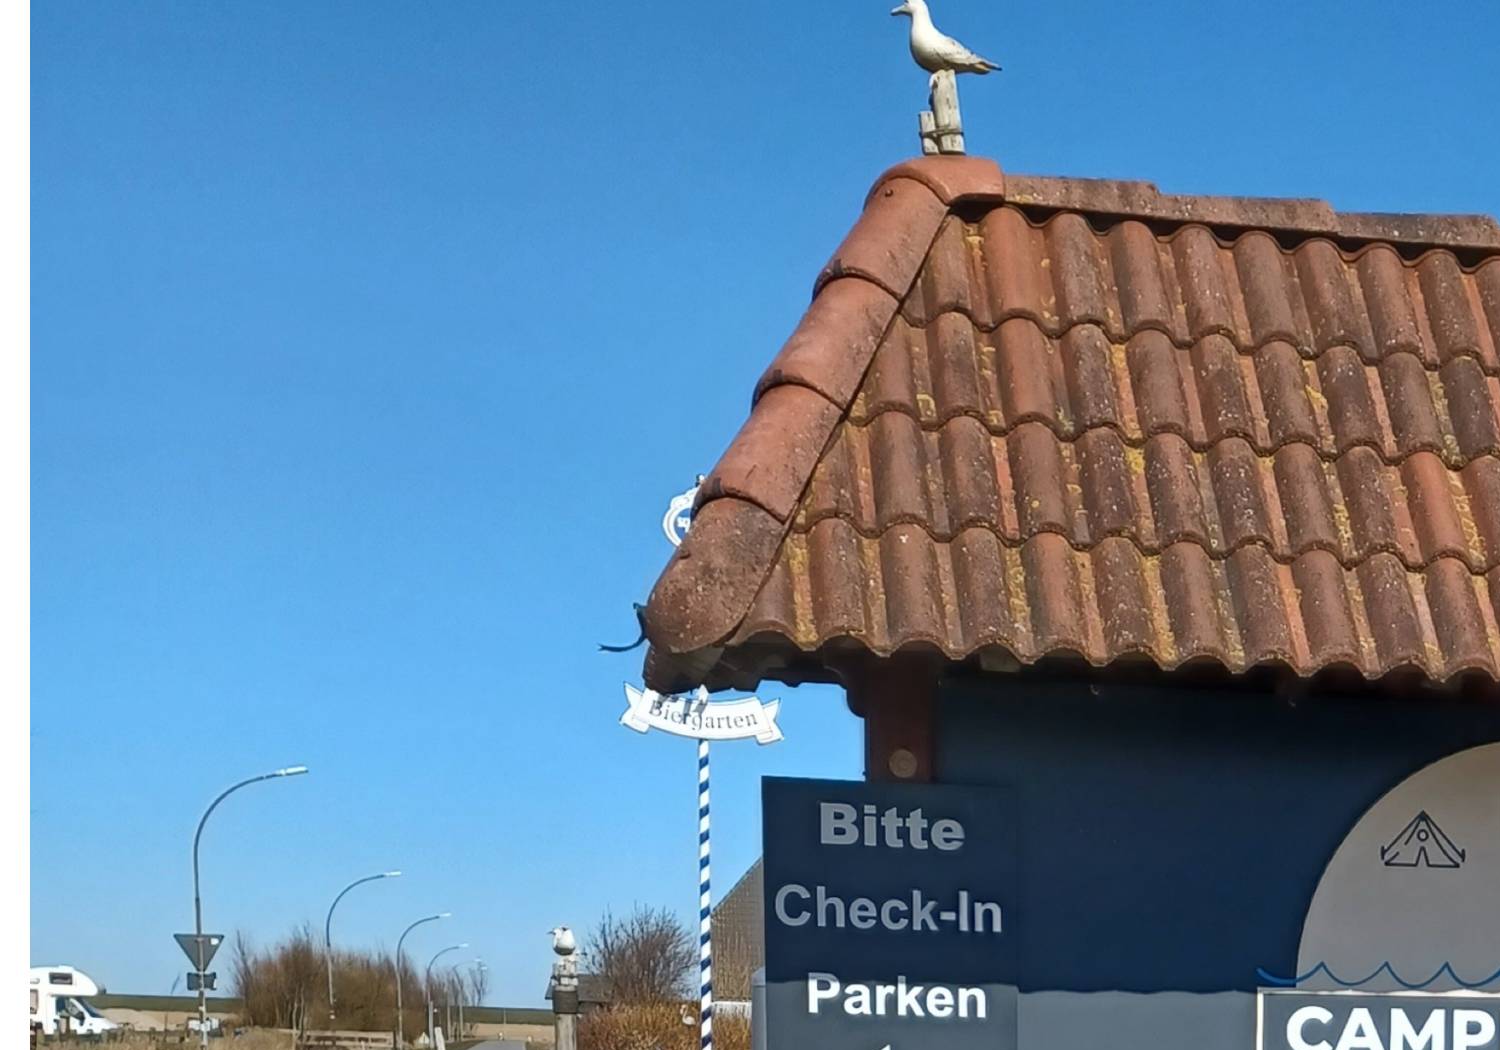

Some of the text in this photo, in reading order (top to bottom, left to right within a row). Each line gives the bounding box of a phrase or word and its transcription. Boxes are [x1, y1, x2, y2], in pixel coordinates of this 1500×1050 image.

[648, 698, 759, 730] Biergarten
[819, 801, 966, 851] Bitte
[774, 883, 1003, 933] Check-In
[806, 972, 988, 1020] Parken
